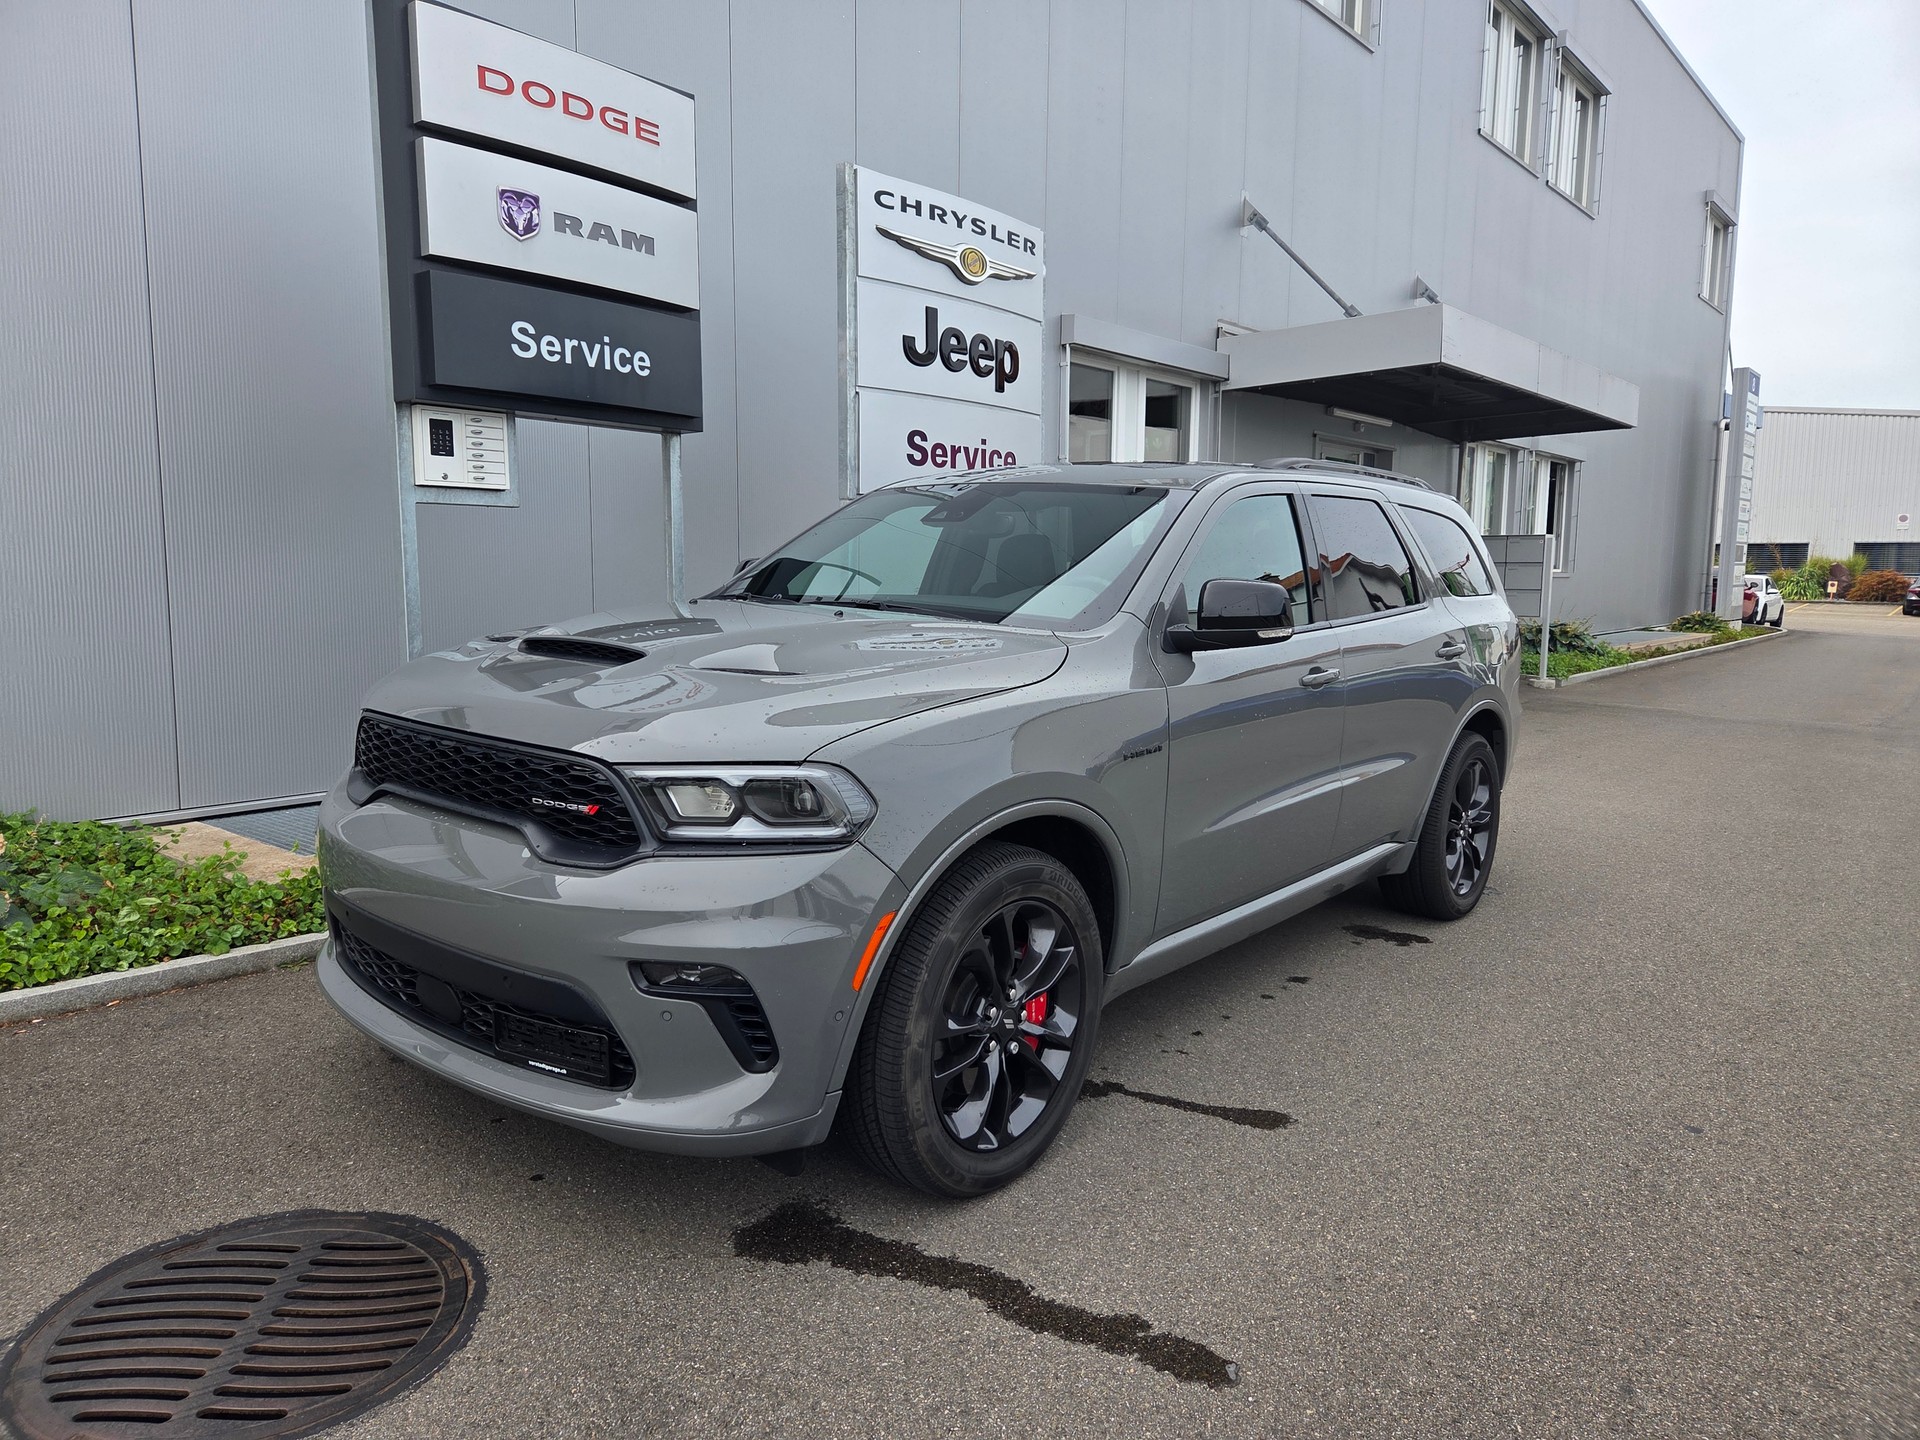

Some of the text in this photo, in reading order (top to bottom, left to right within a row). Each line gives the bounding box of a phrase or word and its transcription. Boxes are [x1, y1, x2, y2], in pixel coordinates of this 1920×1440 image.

[477, 64, 661, 147] DODGE
[553, 211, 656, 257] RAM
[873, 190, 1037, 256] CHRYSLER
[510, 320, 651, 377] Service
[902, 305, 1021, 393] Jeep
[906, 429, 1017, 470] Service
[531, 797, 590, 812] DODGE
